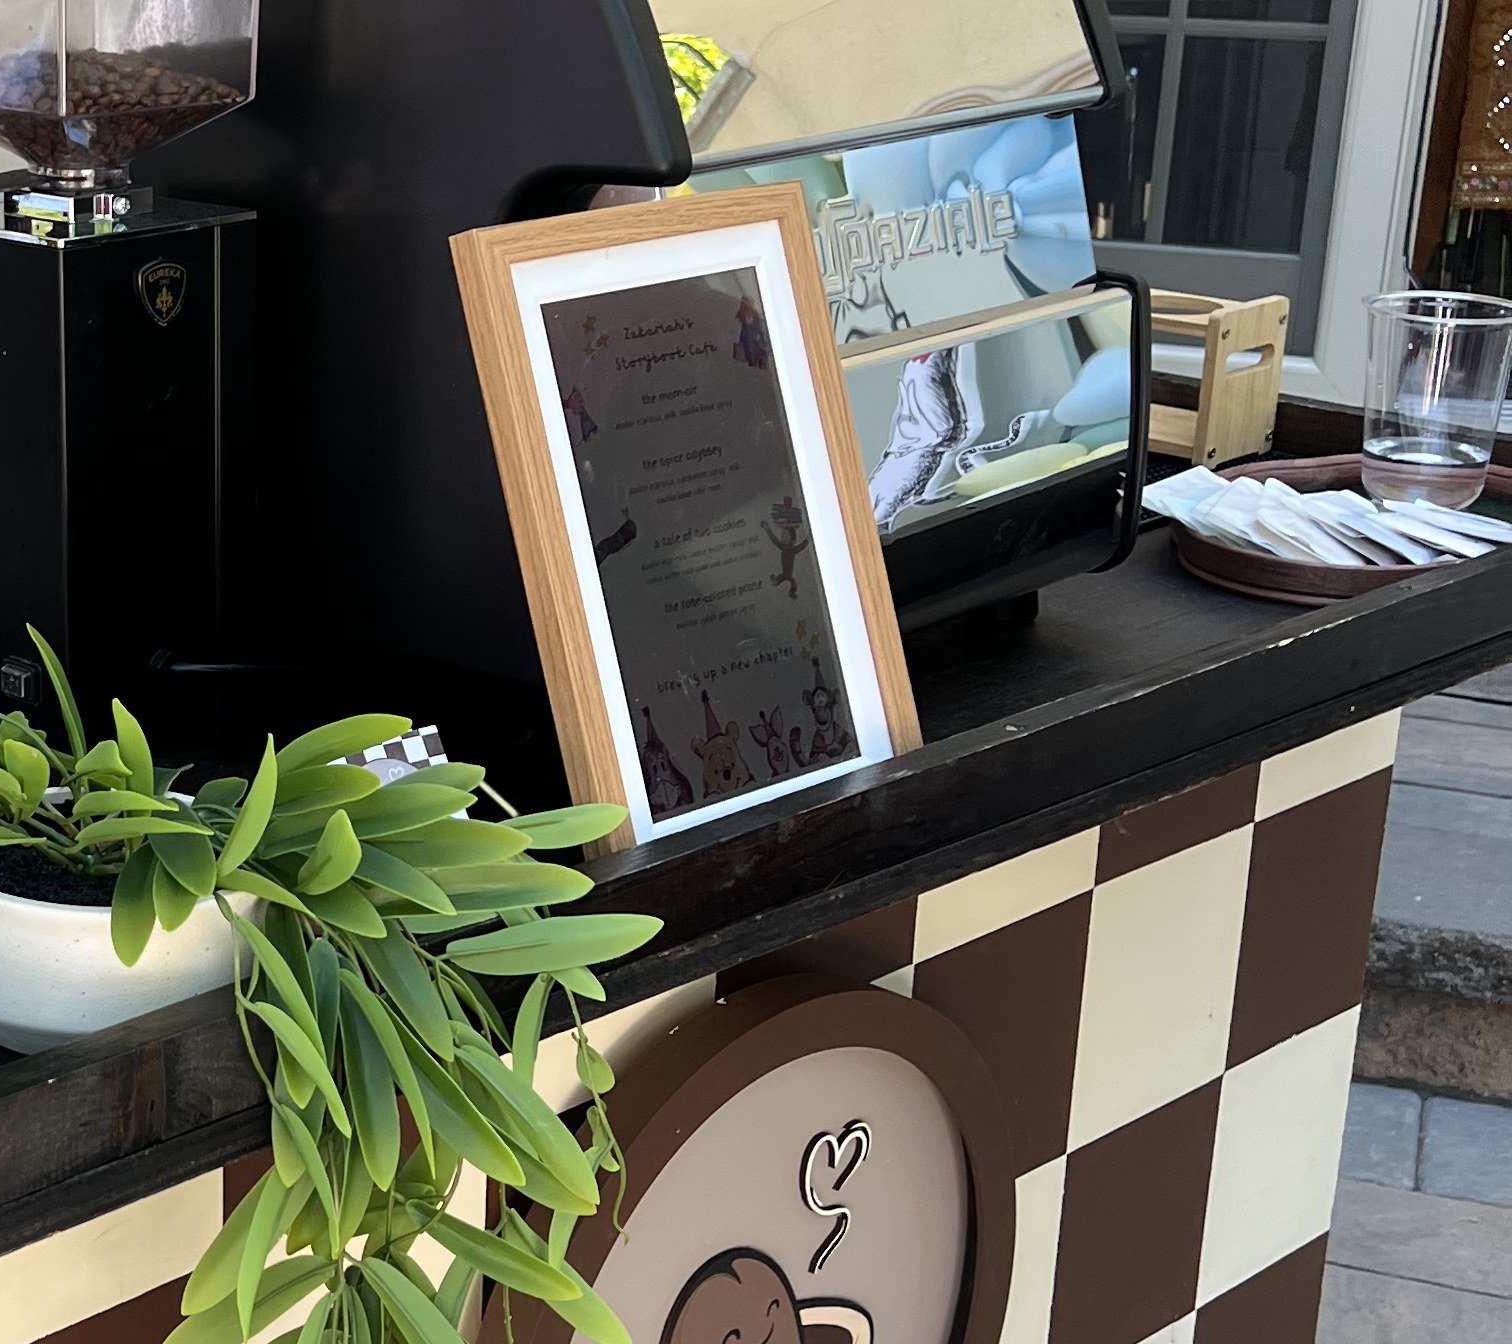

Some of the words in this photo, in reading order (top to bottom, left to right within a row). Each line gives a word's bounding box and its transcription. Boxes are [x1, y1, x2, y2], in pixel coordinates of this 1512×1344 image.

[148, 267, 181, 283] EUREKA
[615, 347, 687, 373] Storybook
[686, 445, 723, 464] odyssey
[703, 668, 717, 683] up
[730, 659, 750, 673] new
[754, 645, 794, 666] chapter
